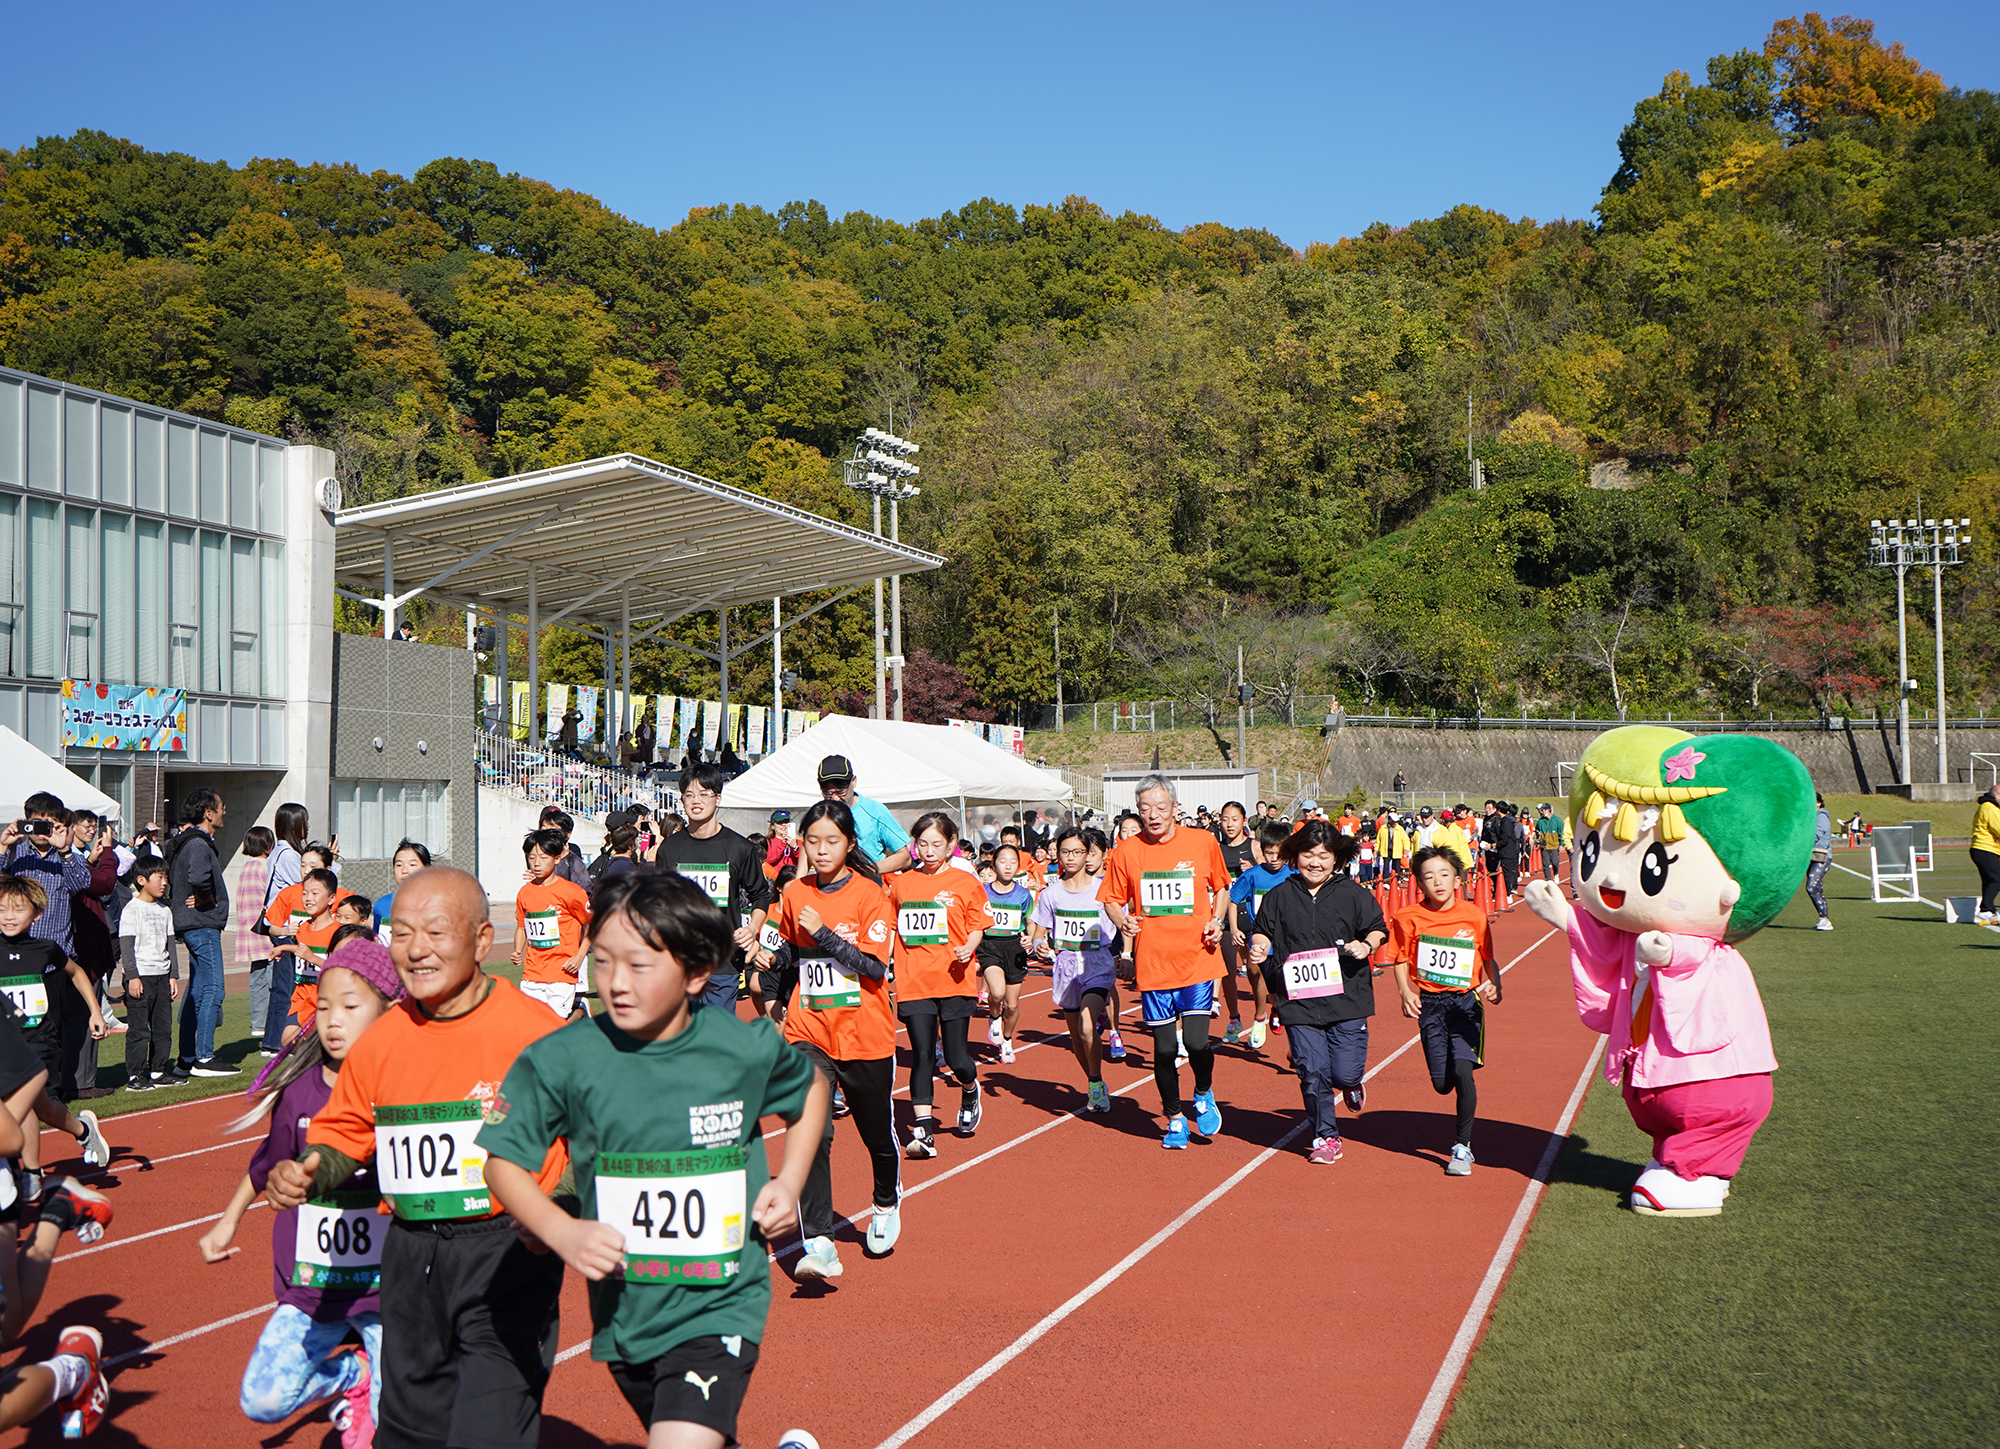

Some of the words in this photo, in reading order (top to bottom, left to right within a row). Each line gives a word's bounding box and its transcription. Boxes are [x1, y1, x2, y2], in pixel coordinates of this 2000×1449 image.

[73, 709, 177, 729] スポーツフェスティバル
[1148, 883, 1182, 901] 1115
[528, 921, 545, 936] 312
[905, 912, 936, 930] 1207
[992, 912, 1009, 926] 03
[1063, 920, 1086, 937] 705
[1429, 948, 1457, 970] 303
[807, 962, 834, 988] 901
[1292, 961, 1327, 984] 3001
[690, 1110, 744, 1136] ROAD
[691, 1127, 742, 1146] MARATHON
[389, 1133, 458, 1180] 1102
[413, 1199, 436, 1213] 一般
[462, 1196, 490, 1211] 3km
[632, 1188, 705, 1239] 420
[317, 1216, 372, 1256] 608
[633, 1260, 723, 1279] 小学5・6年生
